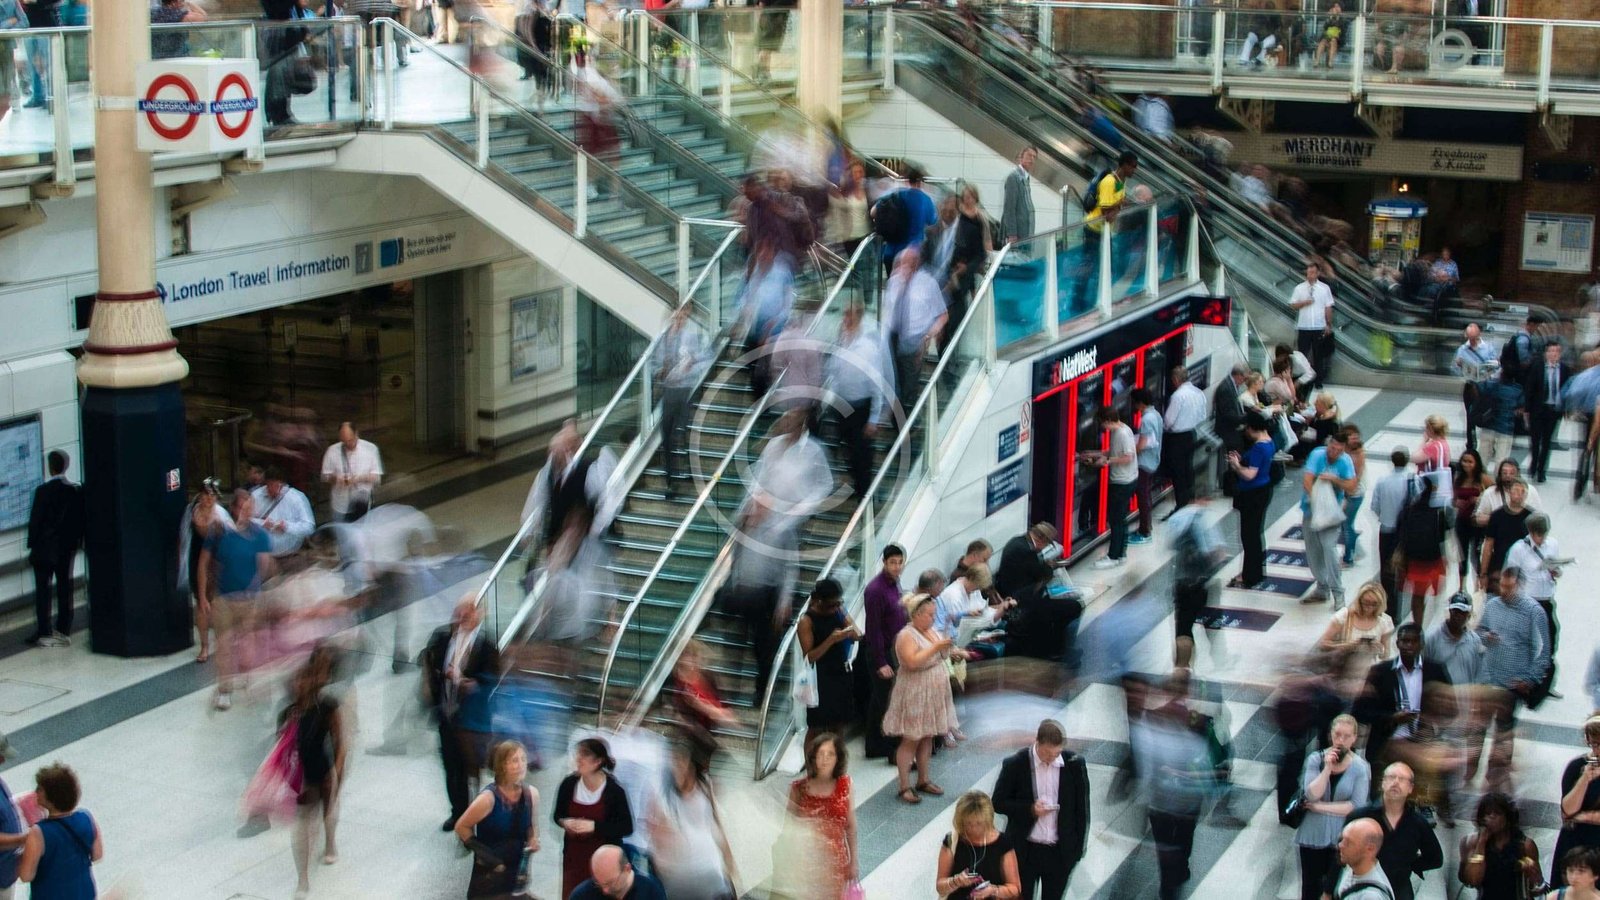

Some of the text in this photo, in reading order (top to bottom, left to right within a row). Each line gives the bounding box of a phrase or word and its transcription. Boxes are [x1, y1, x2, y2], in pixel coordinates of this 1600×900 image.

[142, 100, 203, 112] UNDERGROUND
[212, 98, 256, 112] UNDERGROUND
[1284, 137, 1376, 157] MERCHANT
[1296, 153, 1363, 167] BISHOPSGATE
[172, 254, 350, 301] London Travel Information
[1062, 344, 1097, 382] NatWest
